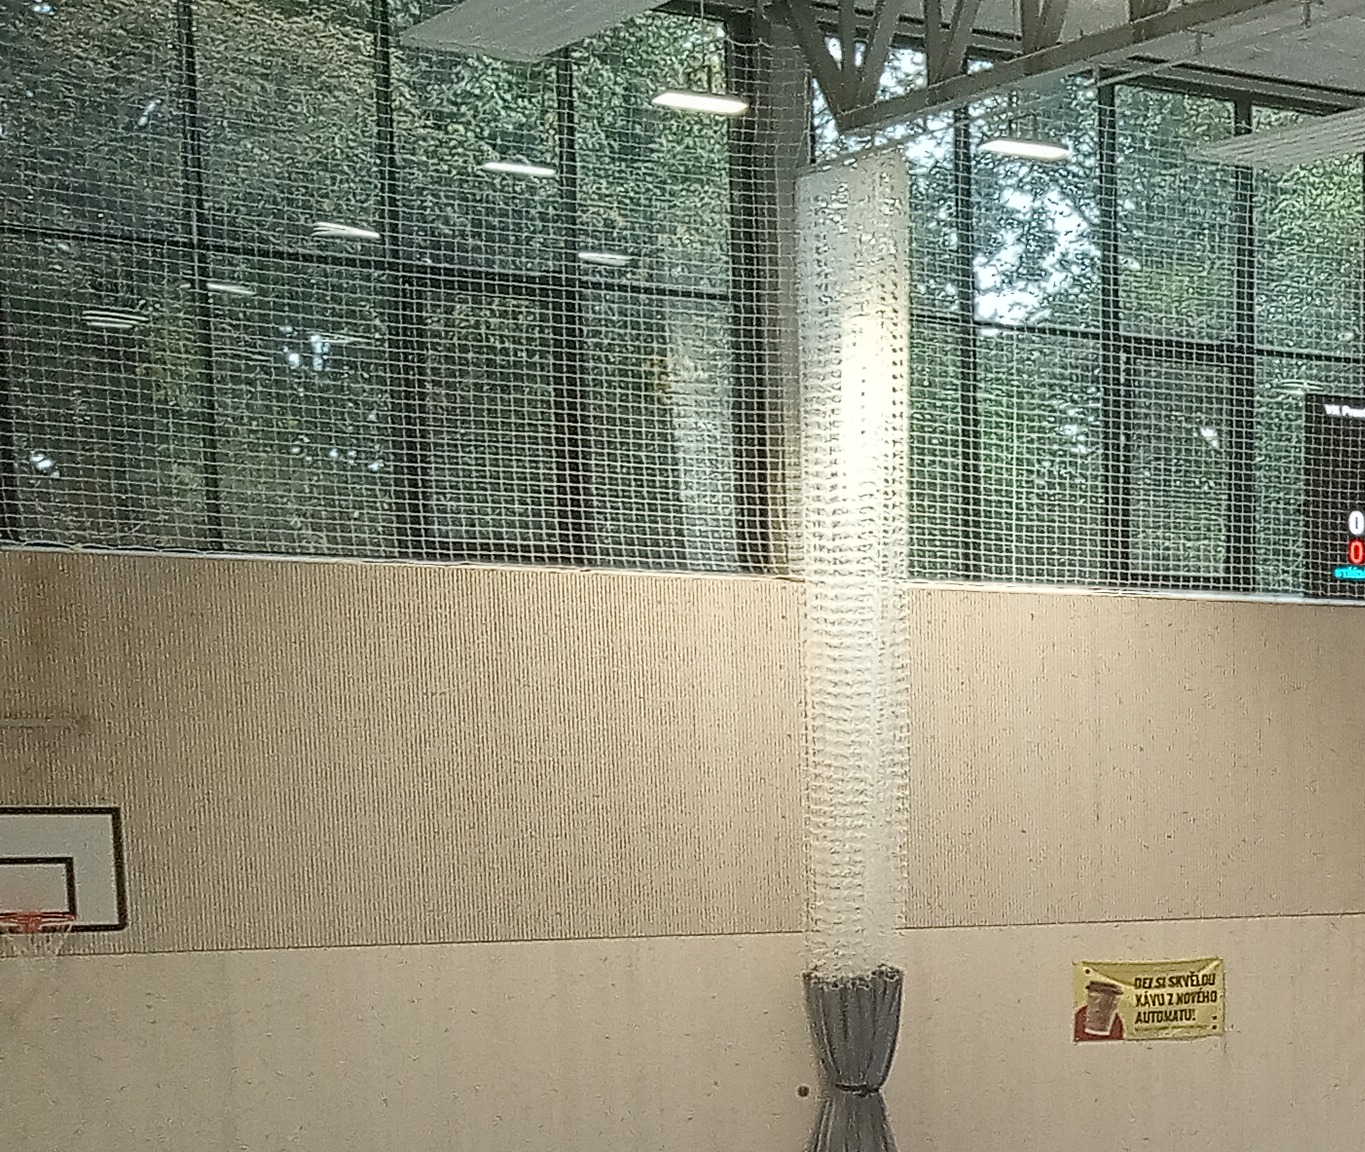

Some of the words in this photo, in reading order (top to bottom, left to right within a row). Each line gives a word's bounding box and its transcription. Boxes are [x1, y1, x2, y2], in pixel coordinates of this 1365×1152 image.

[1348, 510, 1364, 536] 0
[1348, 539, 1365, 564] 0
[1135, 990, 1165, 1007] KÁVU
[1167, 993, 1174, 1006] Z
[1175, 987, 1217, 1006] NOVÉHO
[1134, 1008, 1196, 1024] AUTOMATU!
